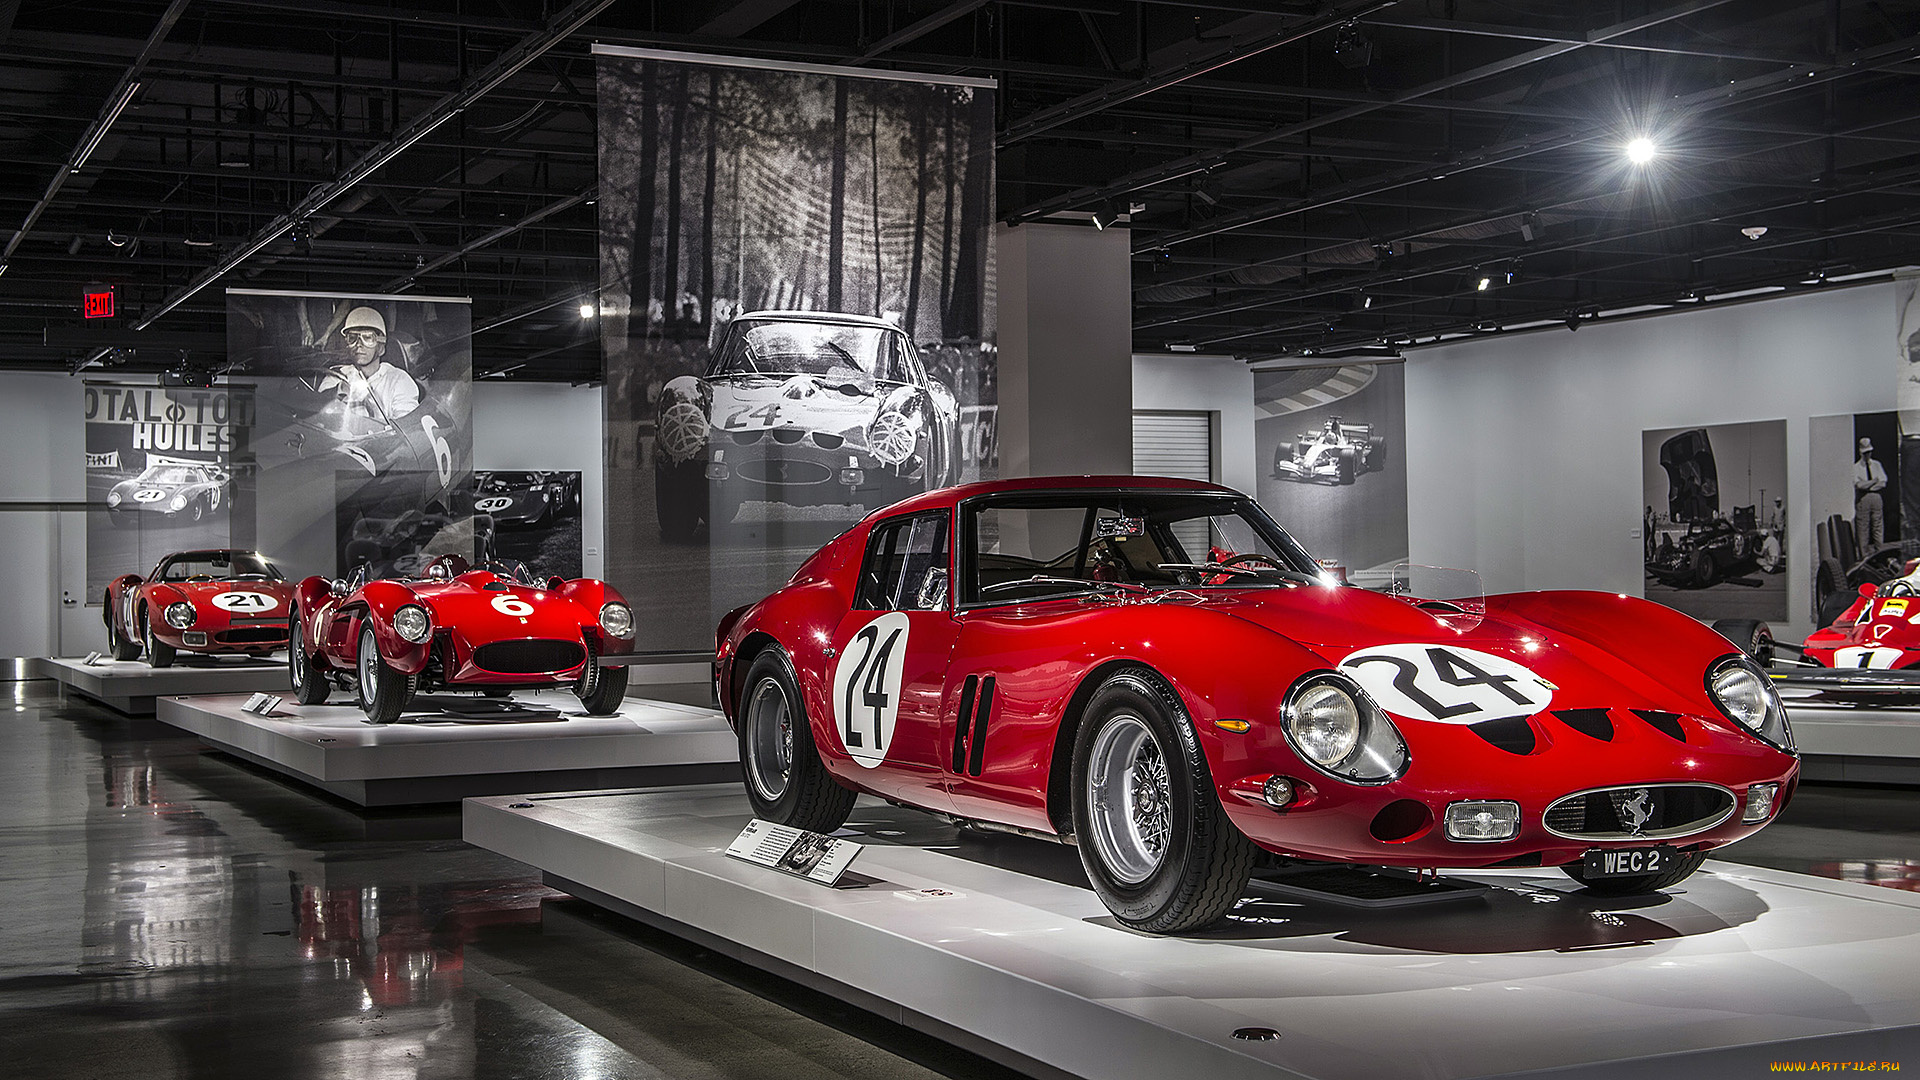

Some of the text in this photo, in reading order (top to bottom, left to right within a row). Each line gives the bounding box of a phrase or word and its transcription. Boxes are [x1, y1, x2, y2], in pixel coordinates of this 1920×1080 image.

[90, 293, 110, 315] EXIT
[724, 403, 781, 429] 24
[133, 423, 236, 452] HUILES
[421, 415, 451, 488] 6
[138, 491, 160, 499] 21
[481, 500, 507, 508] 30
[224, 594, 265, 607] 21
[491, 595, 534, 616] 6
[314, 600, 334, 646] 6
[1857, 651, 1876, 668] 1
[846, 625, 903, 750] 24
[1342, 648, 1535, 720] 24
[1604, 850, 1660, 874] WEC 2
